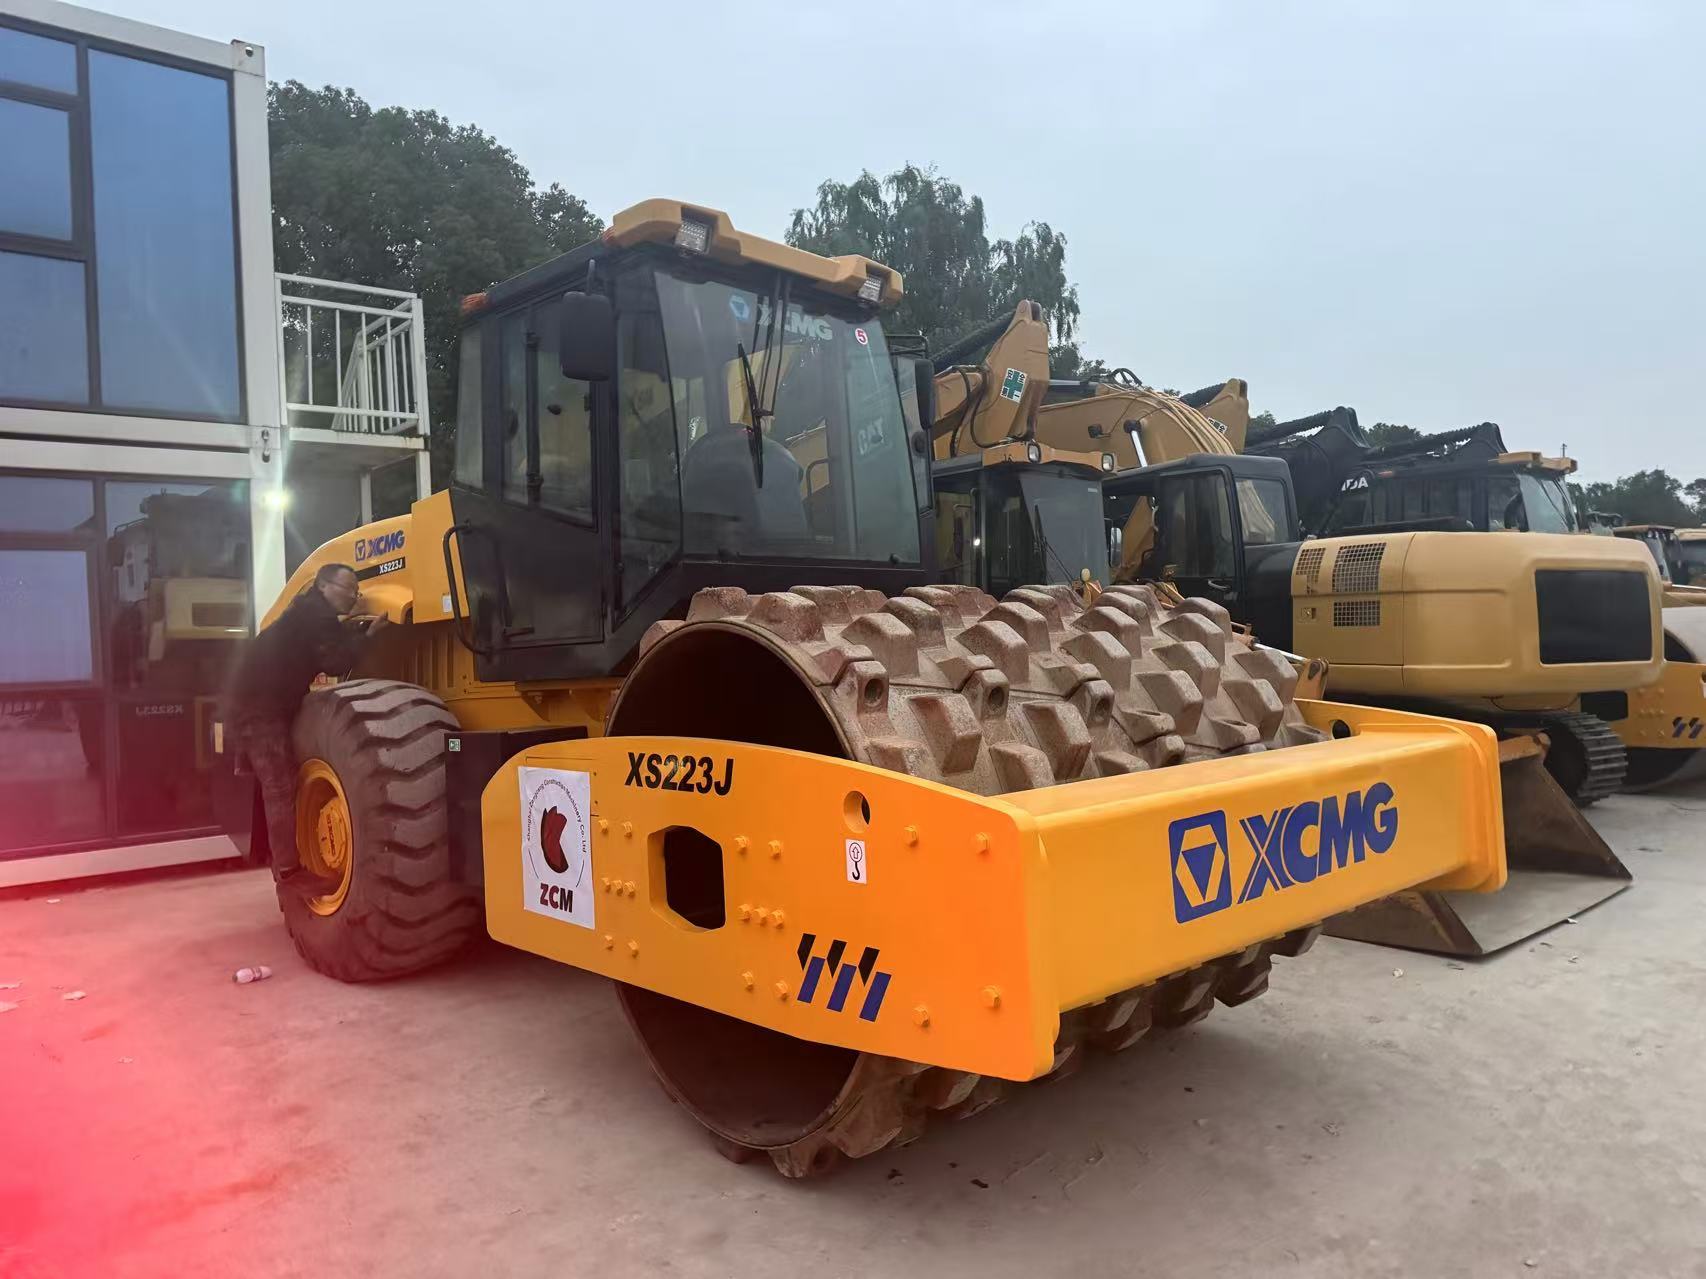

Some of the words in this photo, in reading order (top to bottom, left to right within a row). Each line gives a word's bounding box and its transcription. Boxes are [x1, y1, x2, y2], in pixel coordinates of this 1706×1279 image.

[366, 529, 406, 559] XCMG
[379, 559, 403, 575] XS223J
[623, 751, 735, 796] XS223J
[1236, 781, 1399, 905] XCMG
[539, 882, 574, 913] ZCM
